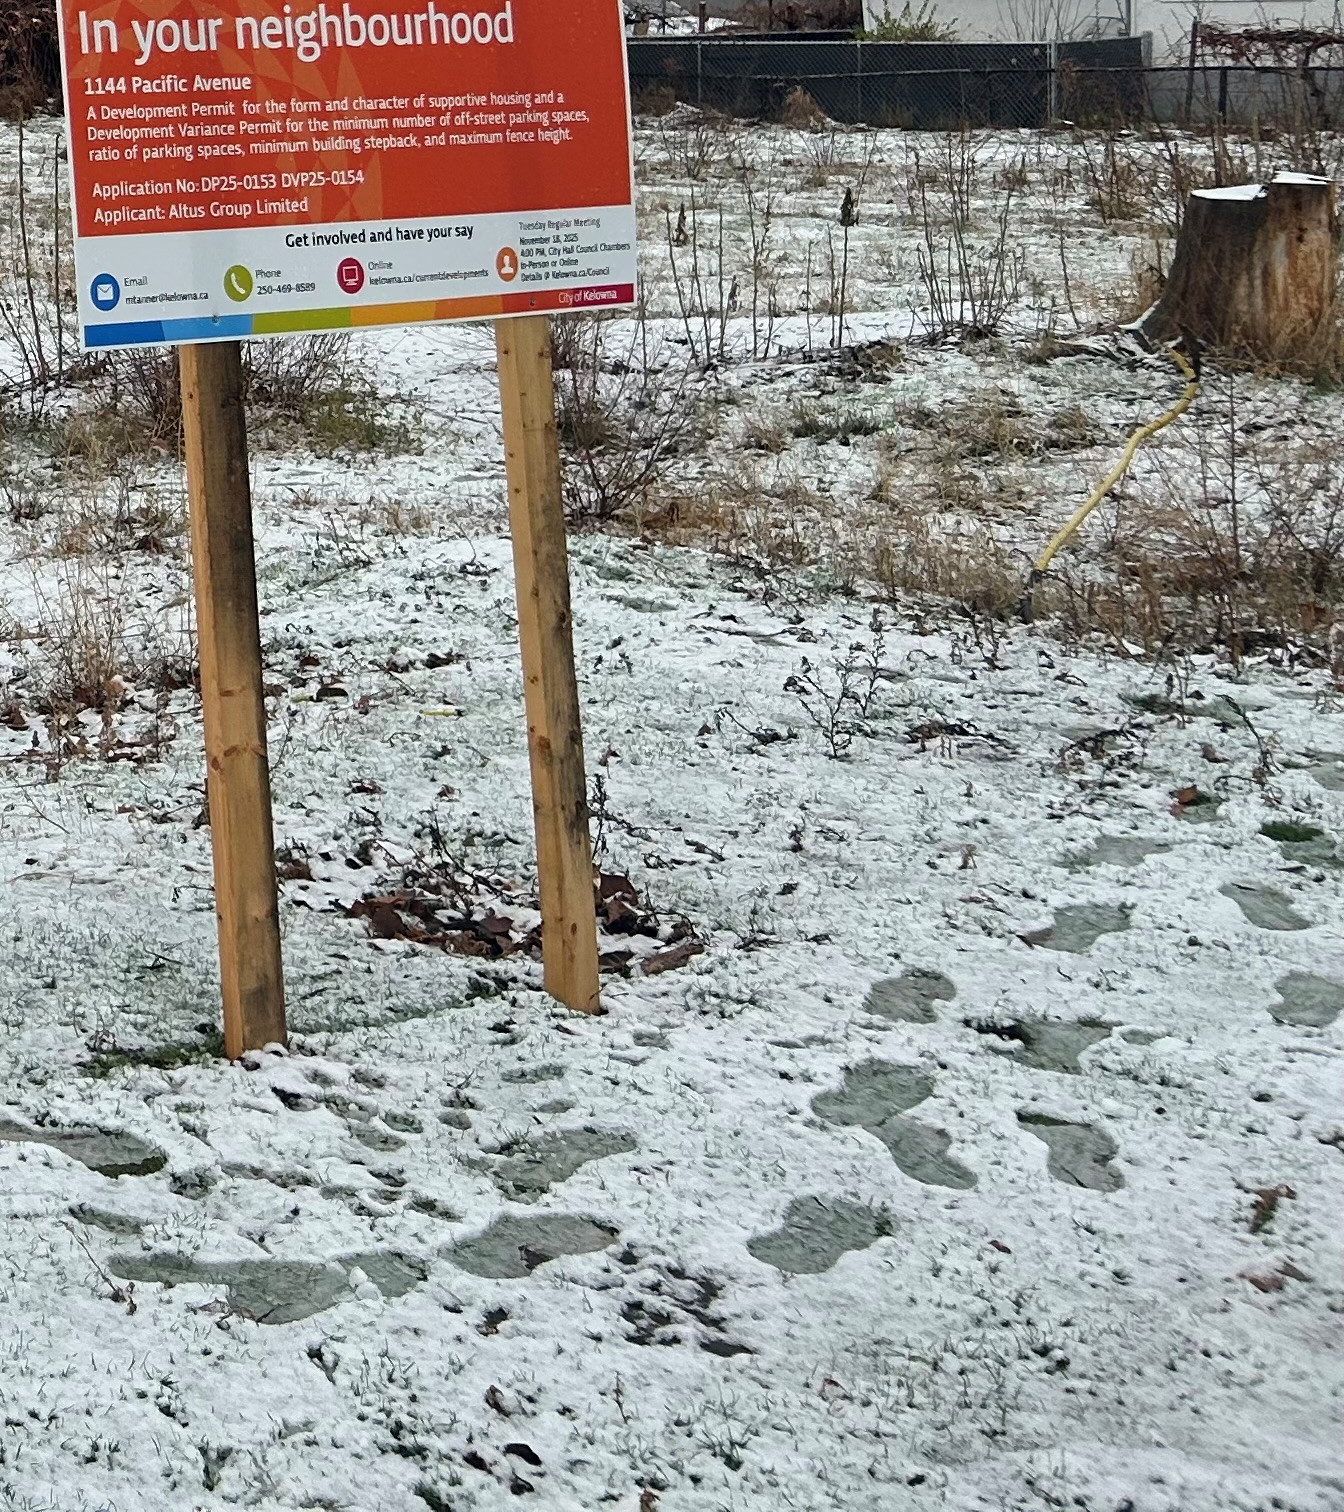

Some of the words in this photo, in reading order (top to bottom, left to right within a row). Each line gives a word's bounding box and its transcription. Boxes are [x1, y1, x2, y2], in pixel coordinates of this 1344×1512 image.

[78, 10, 118, 55] In
[131, 16, 223, 66] your
[235, 1, 514, 63] neighbourhood
[84, 77, 126, 95] 1144
[131, 76, 188, 93] Pacific
[193, 75, 251, 91] Avenue
[86, 106, 96, 120] A
[101, 102, 187, 122] Development
[192, 101, 235, 116] Permit
[242, 99, 261, 114] for
[265, 98, 286, 114] the
[290, 97, 321, 113] form
[325, 97, 348, 111] and
[353, 95, 409, 110] character
[413, 94, 426, 108] of
[428, 91, 487, 110] supportive
[490, 91, 531, 108] housing
[534, 90, 554, 104] and
[557, 93, 564, 104] a
[87, 123, 174, 142] Development
[178, 121, 235, 137] Variance
[239, 119, 282, 135] Permit
[285, 118, 303, 133] for
[308, 117, 329, 132] the
[333, 115, 388, 130] minimum
[392, 112, 436, 128] number
[439, 111, 452, 126] of
[454, 110, 506, 126] off-street
[509, 109, 549, 127] parking
[552, 109, 590, 126] spaces,
[89, 145, 120, 161] ratio
[124, 144, 138, 159] of
[142, 143, 194, 162] parking
[197, 142, 245, 161] spaces,
[249, 139, 308, 155] minimum
[312, 136, 361, 154] building
[364, 133, 422, 152] stepback,
[424, 132, 445, 147] and
[449, 130, 502, 146] maximum
[505, 128, 534, 143] fence
[537, 127, 573, 145] height.
[92, 180, 172, 201] Application
[201, 173, 277, 192] DP25-0153
[281, 169, 364, 190] DVP25-0154
[94, 205, 166, 226] Applicant:
[169, 201, 205, 219] Altus
[210, 200, 252, 219] Group
[256, 196, 308, 215] Limited
[519, 221, 546, 231] Tuesday
[574, 217, 601, 229] Meeting
[285, 233, 309, 248] Get
[312, 229, 366, 246] involved
[369, 227, 392, 243] and
[396, 227, 424, 241] have
[427, 226, 452, 242] your
[455, 224, 473, 240] say
[519, 236, 550, 246] November
[563, 233, 579, 243] 2025
[548, 246, 561, 257] City
[562, 245, 574, 255] Hall
[576, 244, 598, 254] Council
[600, 242, 631, 252] Chambers
[368, 260, 393, 271] Online
[551, 259, 557, 267] or
[559, 257, 579, 267] Online
[124, 276, 148, 287] Email
[255, 269, 282, 279] Phone
[520, 272, 543, 282] Details
[558, 291, 573, 305] City
[574, 290, 583, 302] of
[583, 289, 618, 302] Kelowna
